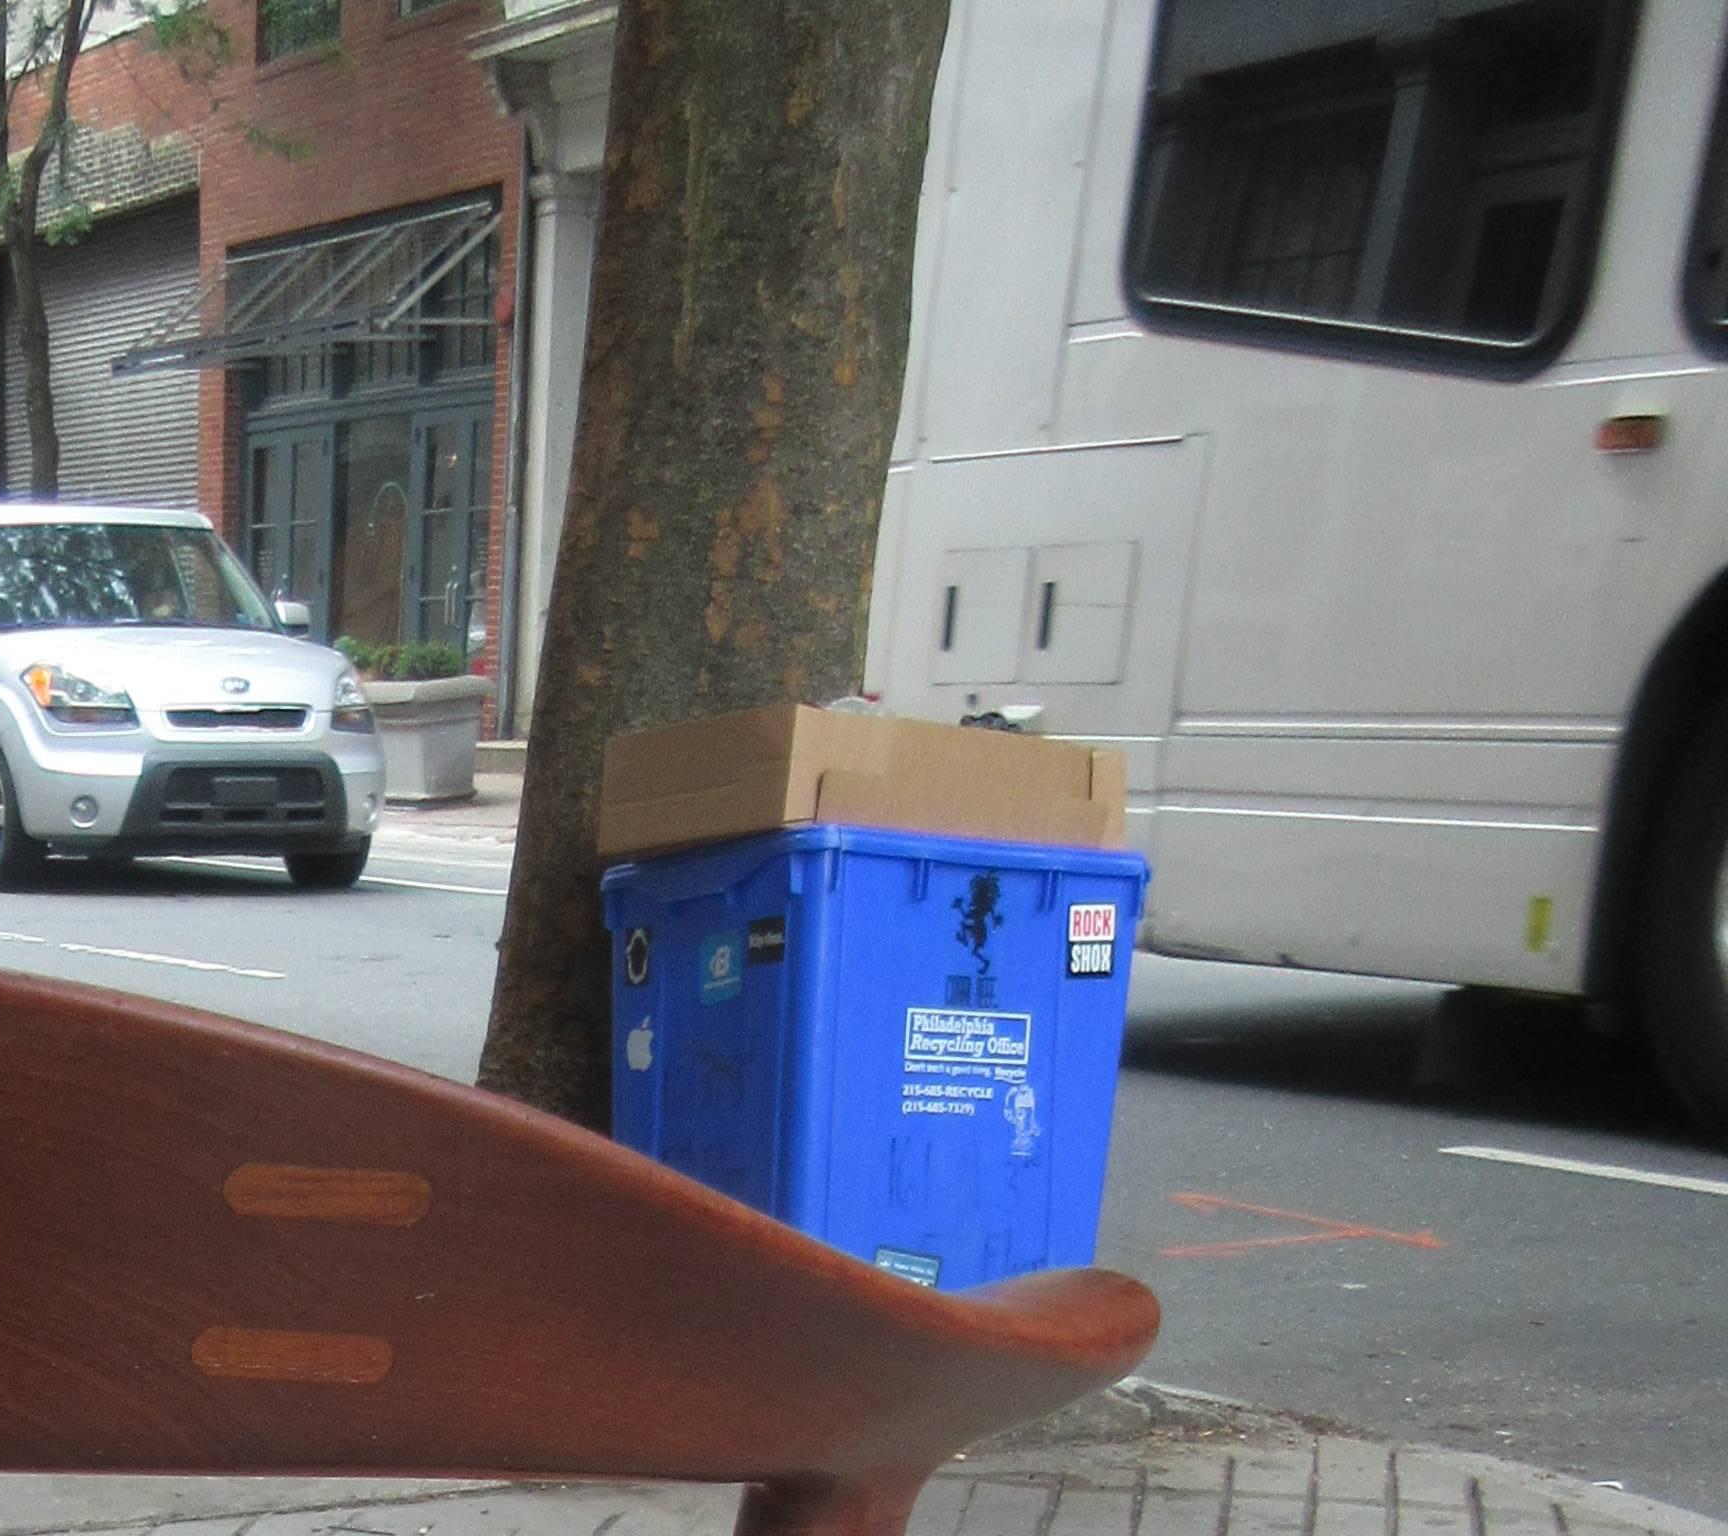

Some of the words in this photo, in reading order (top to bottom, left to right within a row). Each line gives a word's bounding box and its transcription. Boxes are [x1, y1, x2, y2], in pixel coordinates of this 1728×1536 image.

[1072, 909, 1112, 937] ROCK
[1070, 943, 1112, 973] SHOX
[912, 1014, 995, 1038] Philadelphia
[910, 1033, 985, 1057] Recycling
[987, 1037, 1024, 1055] Office
[902, 1084, 994, 1099] 215-685-RECYCLE
